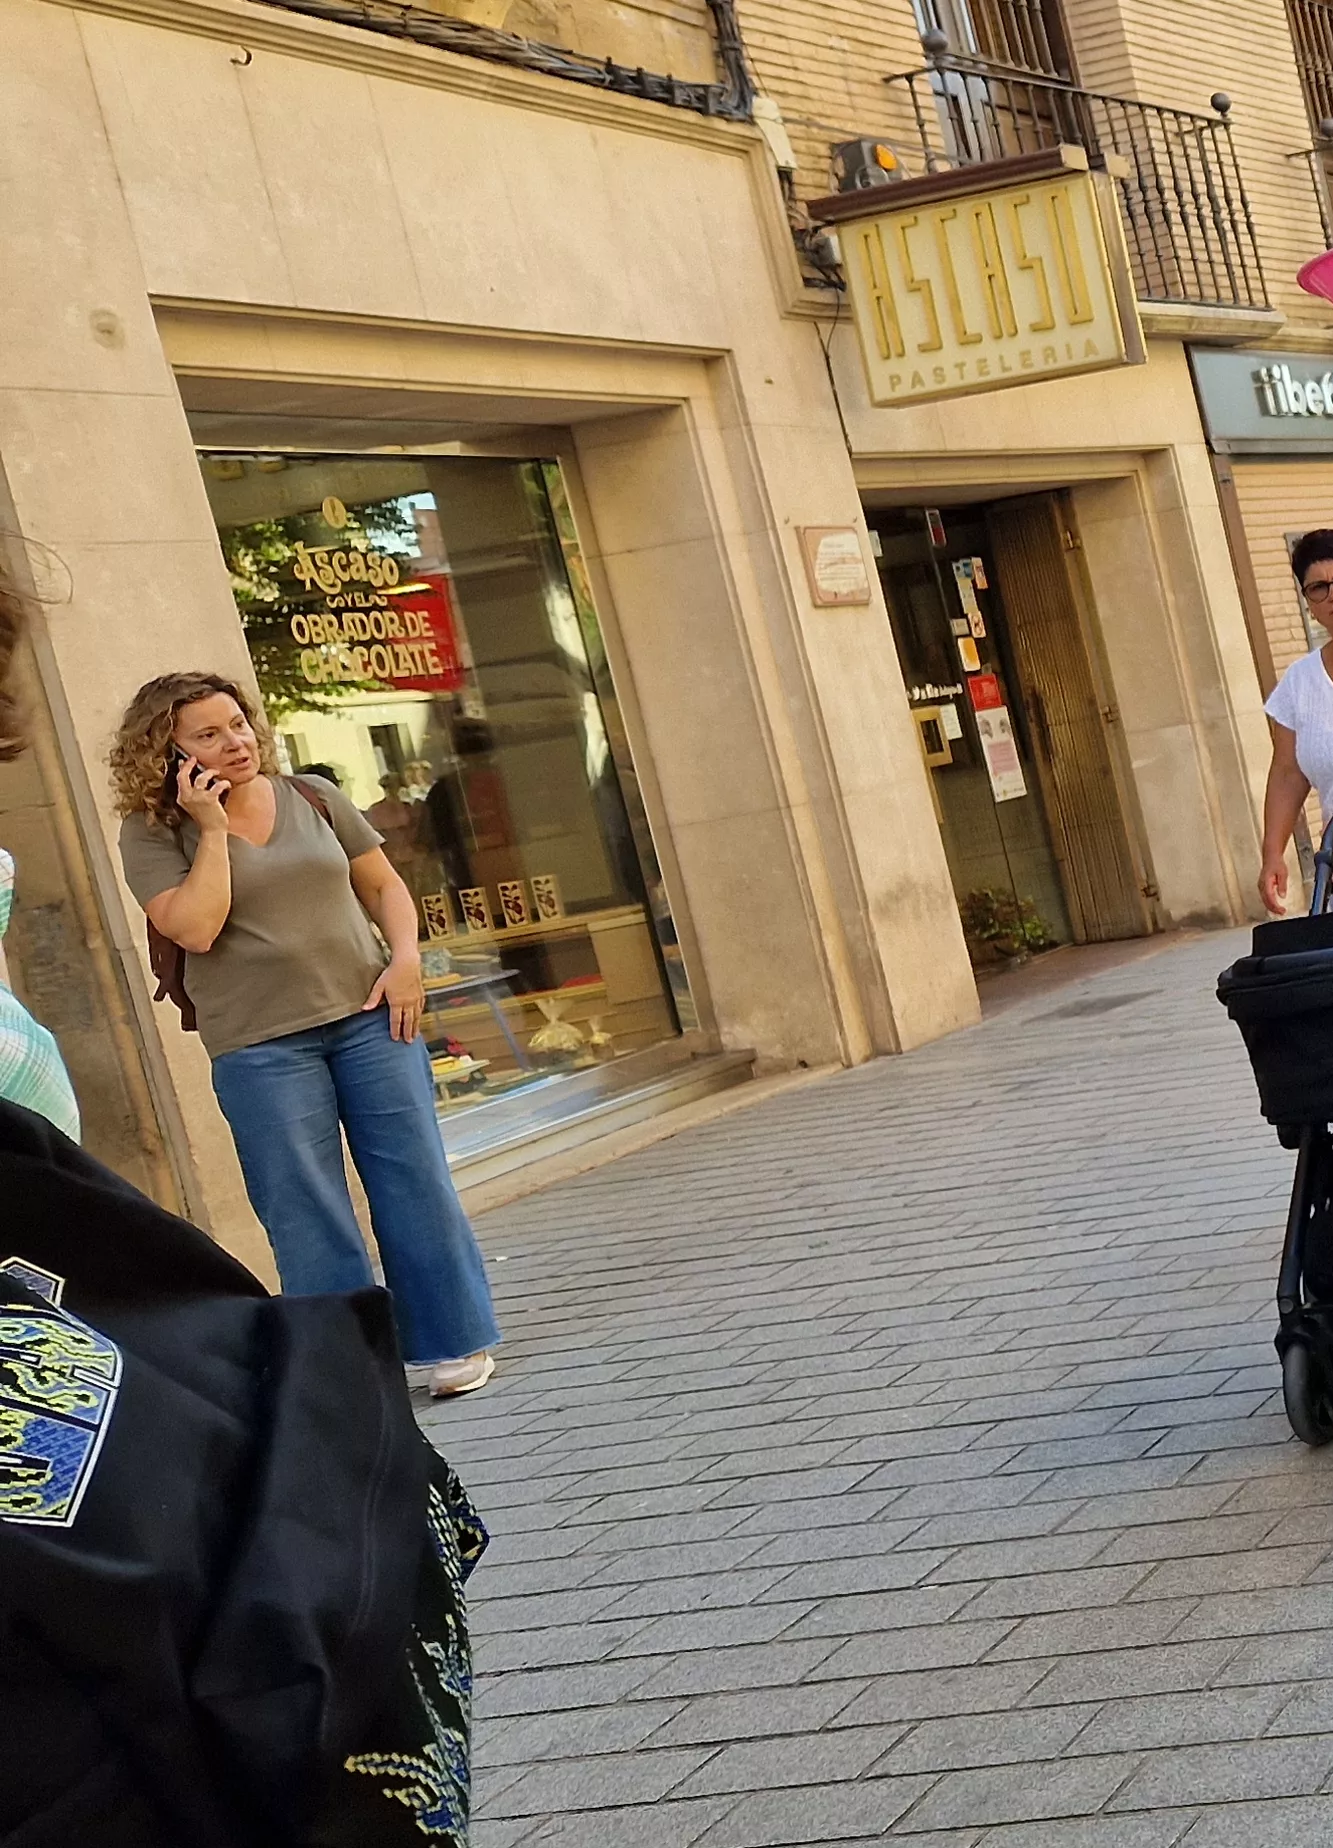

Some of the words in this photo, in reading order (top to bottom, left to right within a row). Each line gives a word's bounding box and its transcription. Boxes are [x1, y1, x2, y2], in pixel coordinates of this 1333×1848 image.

[859, 186, 1094, 360] ASCASO
[889, 338, 1100, 393] PASTELERIA
[291, 611, 404, 645] OBRADOR
[404, 610, 434, 638] DE
[300, 642, 443, 685] CHOCOLATE
